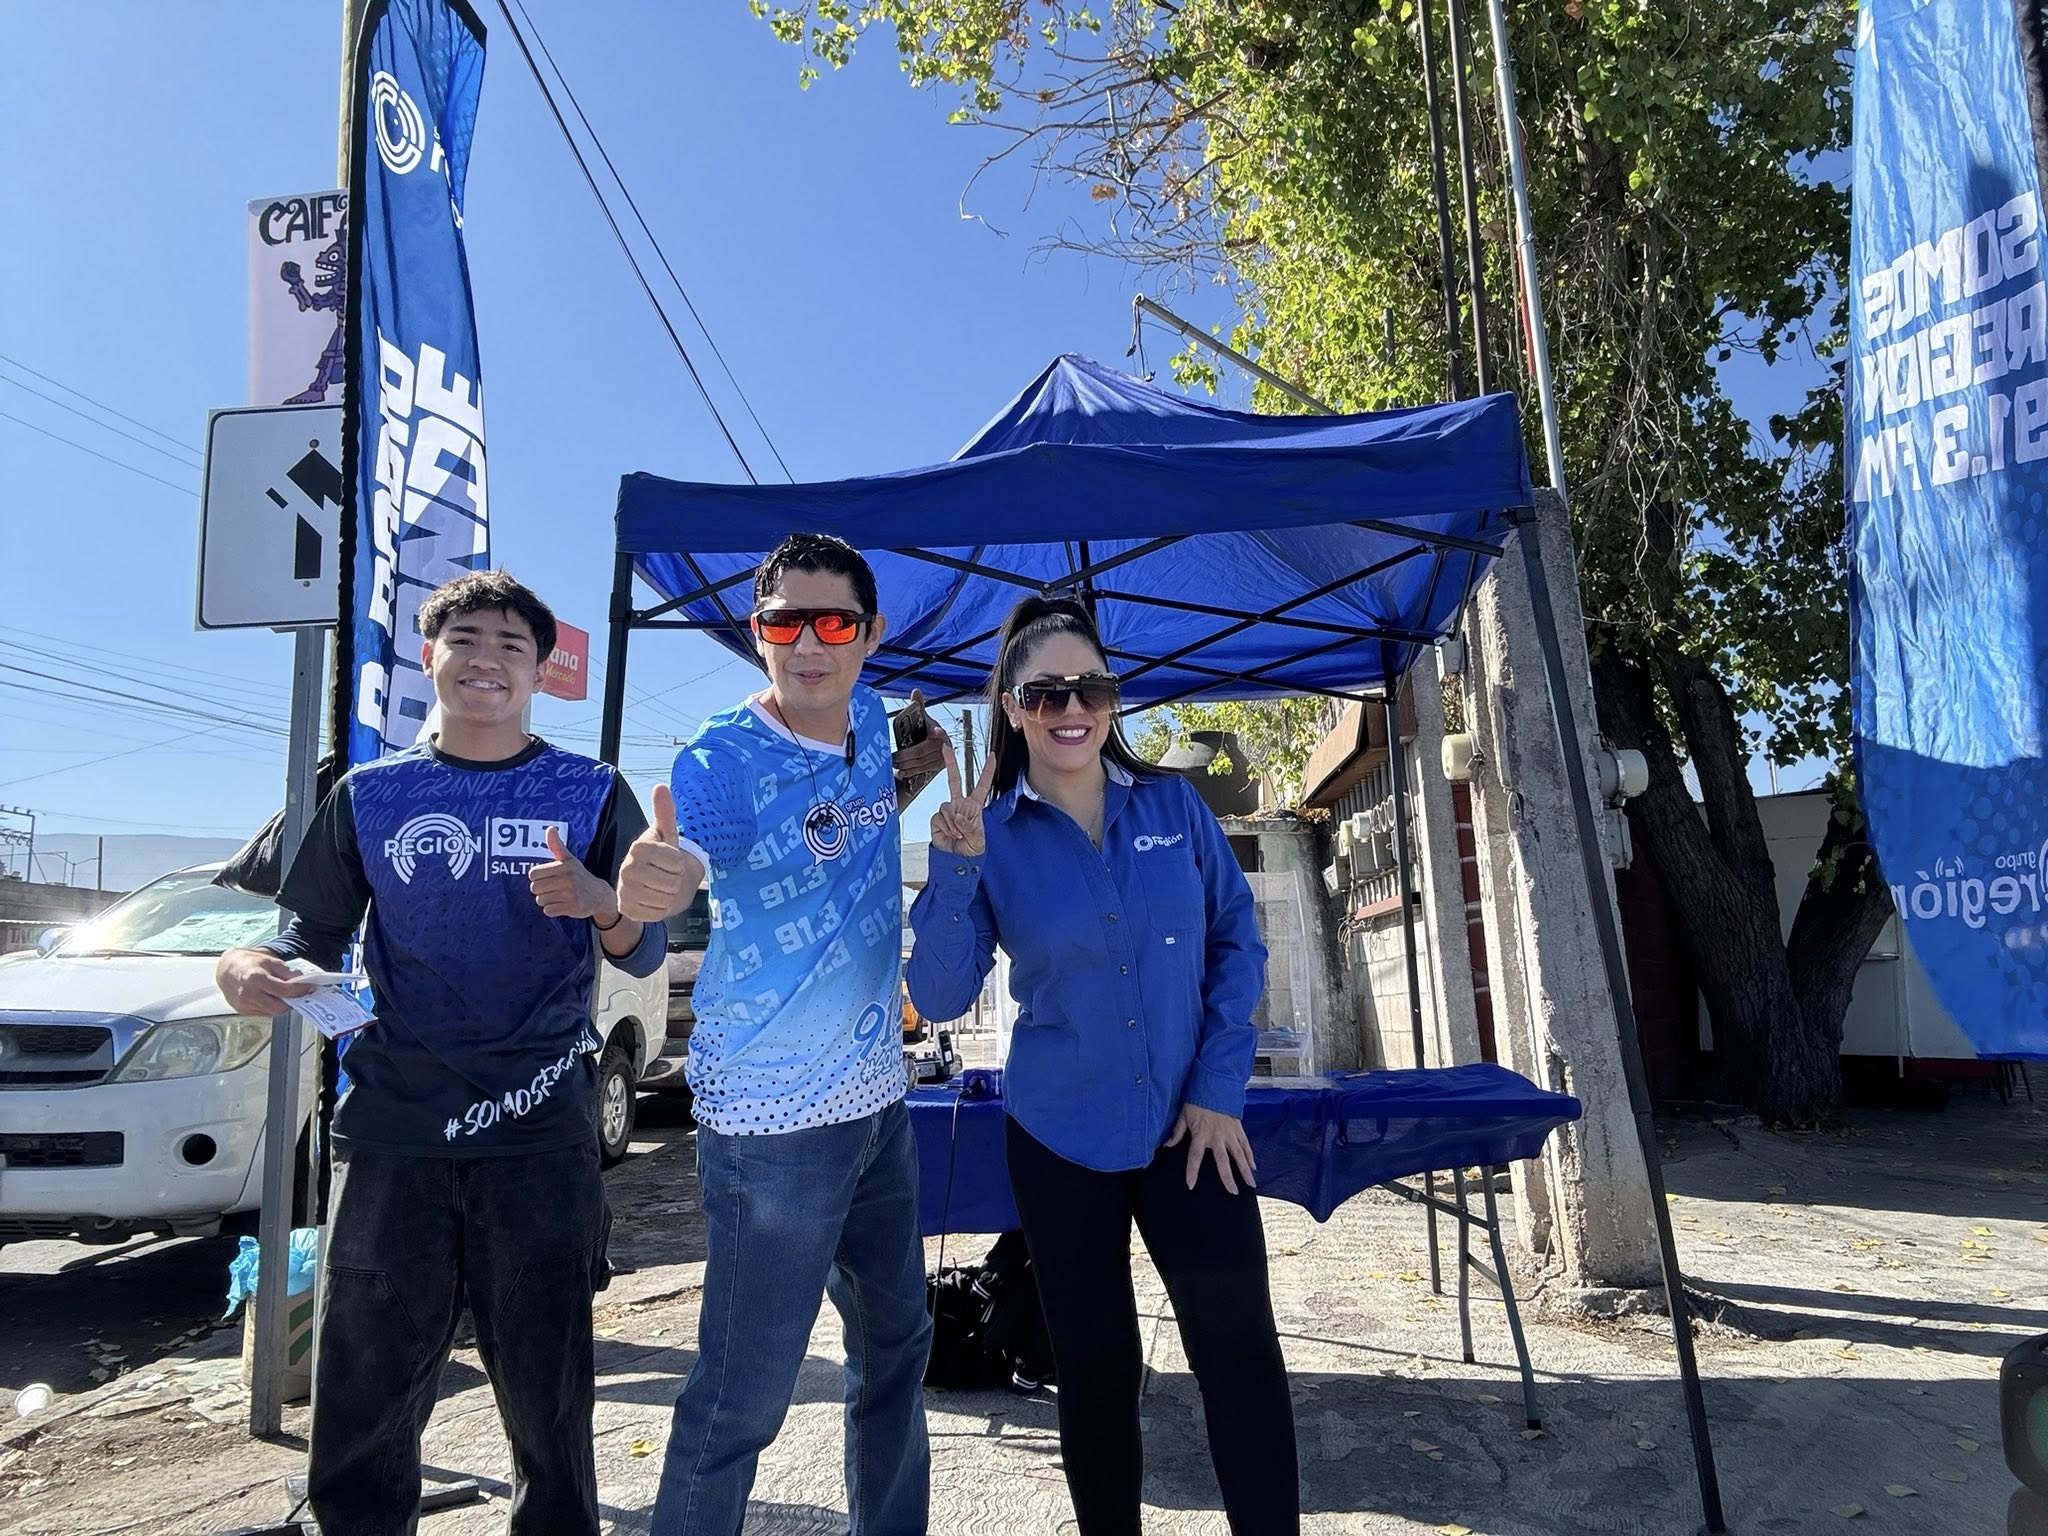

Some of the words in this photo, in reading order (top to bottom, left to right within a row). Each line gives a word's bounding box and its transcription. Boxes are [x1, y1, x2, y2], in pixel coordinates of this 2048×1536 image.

[549, 647, 579, 671] ana
[850, 789, 898, 831] regi
[384, 830, 482, 858] REGIÓN
[491, 861, 541, 875] SALT
[758, 864, 828, 910] 91.3
[774, 900, 843, 955] 91.3
